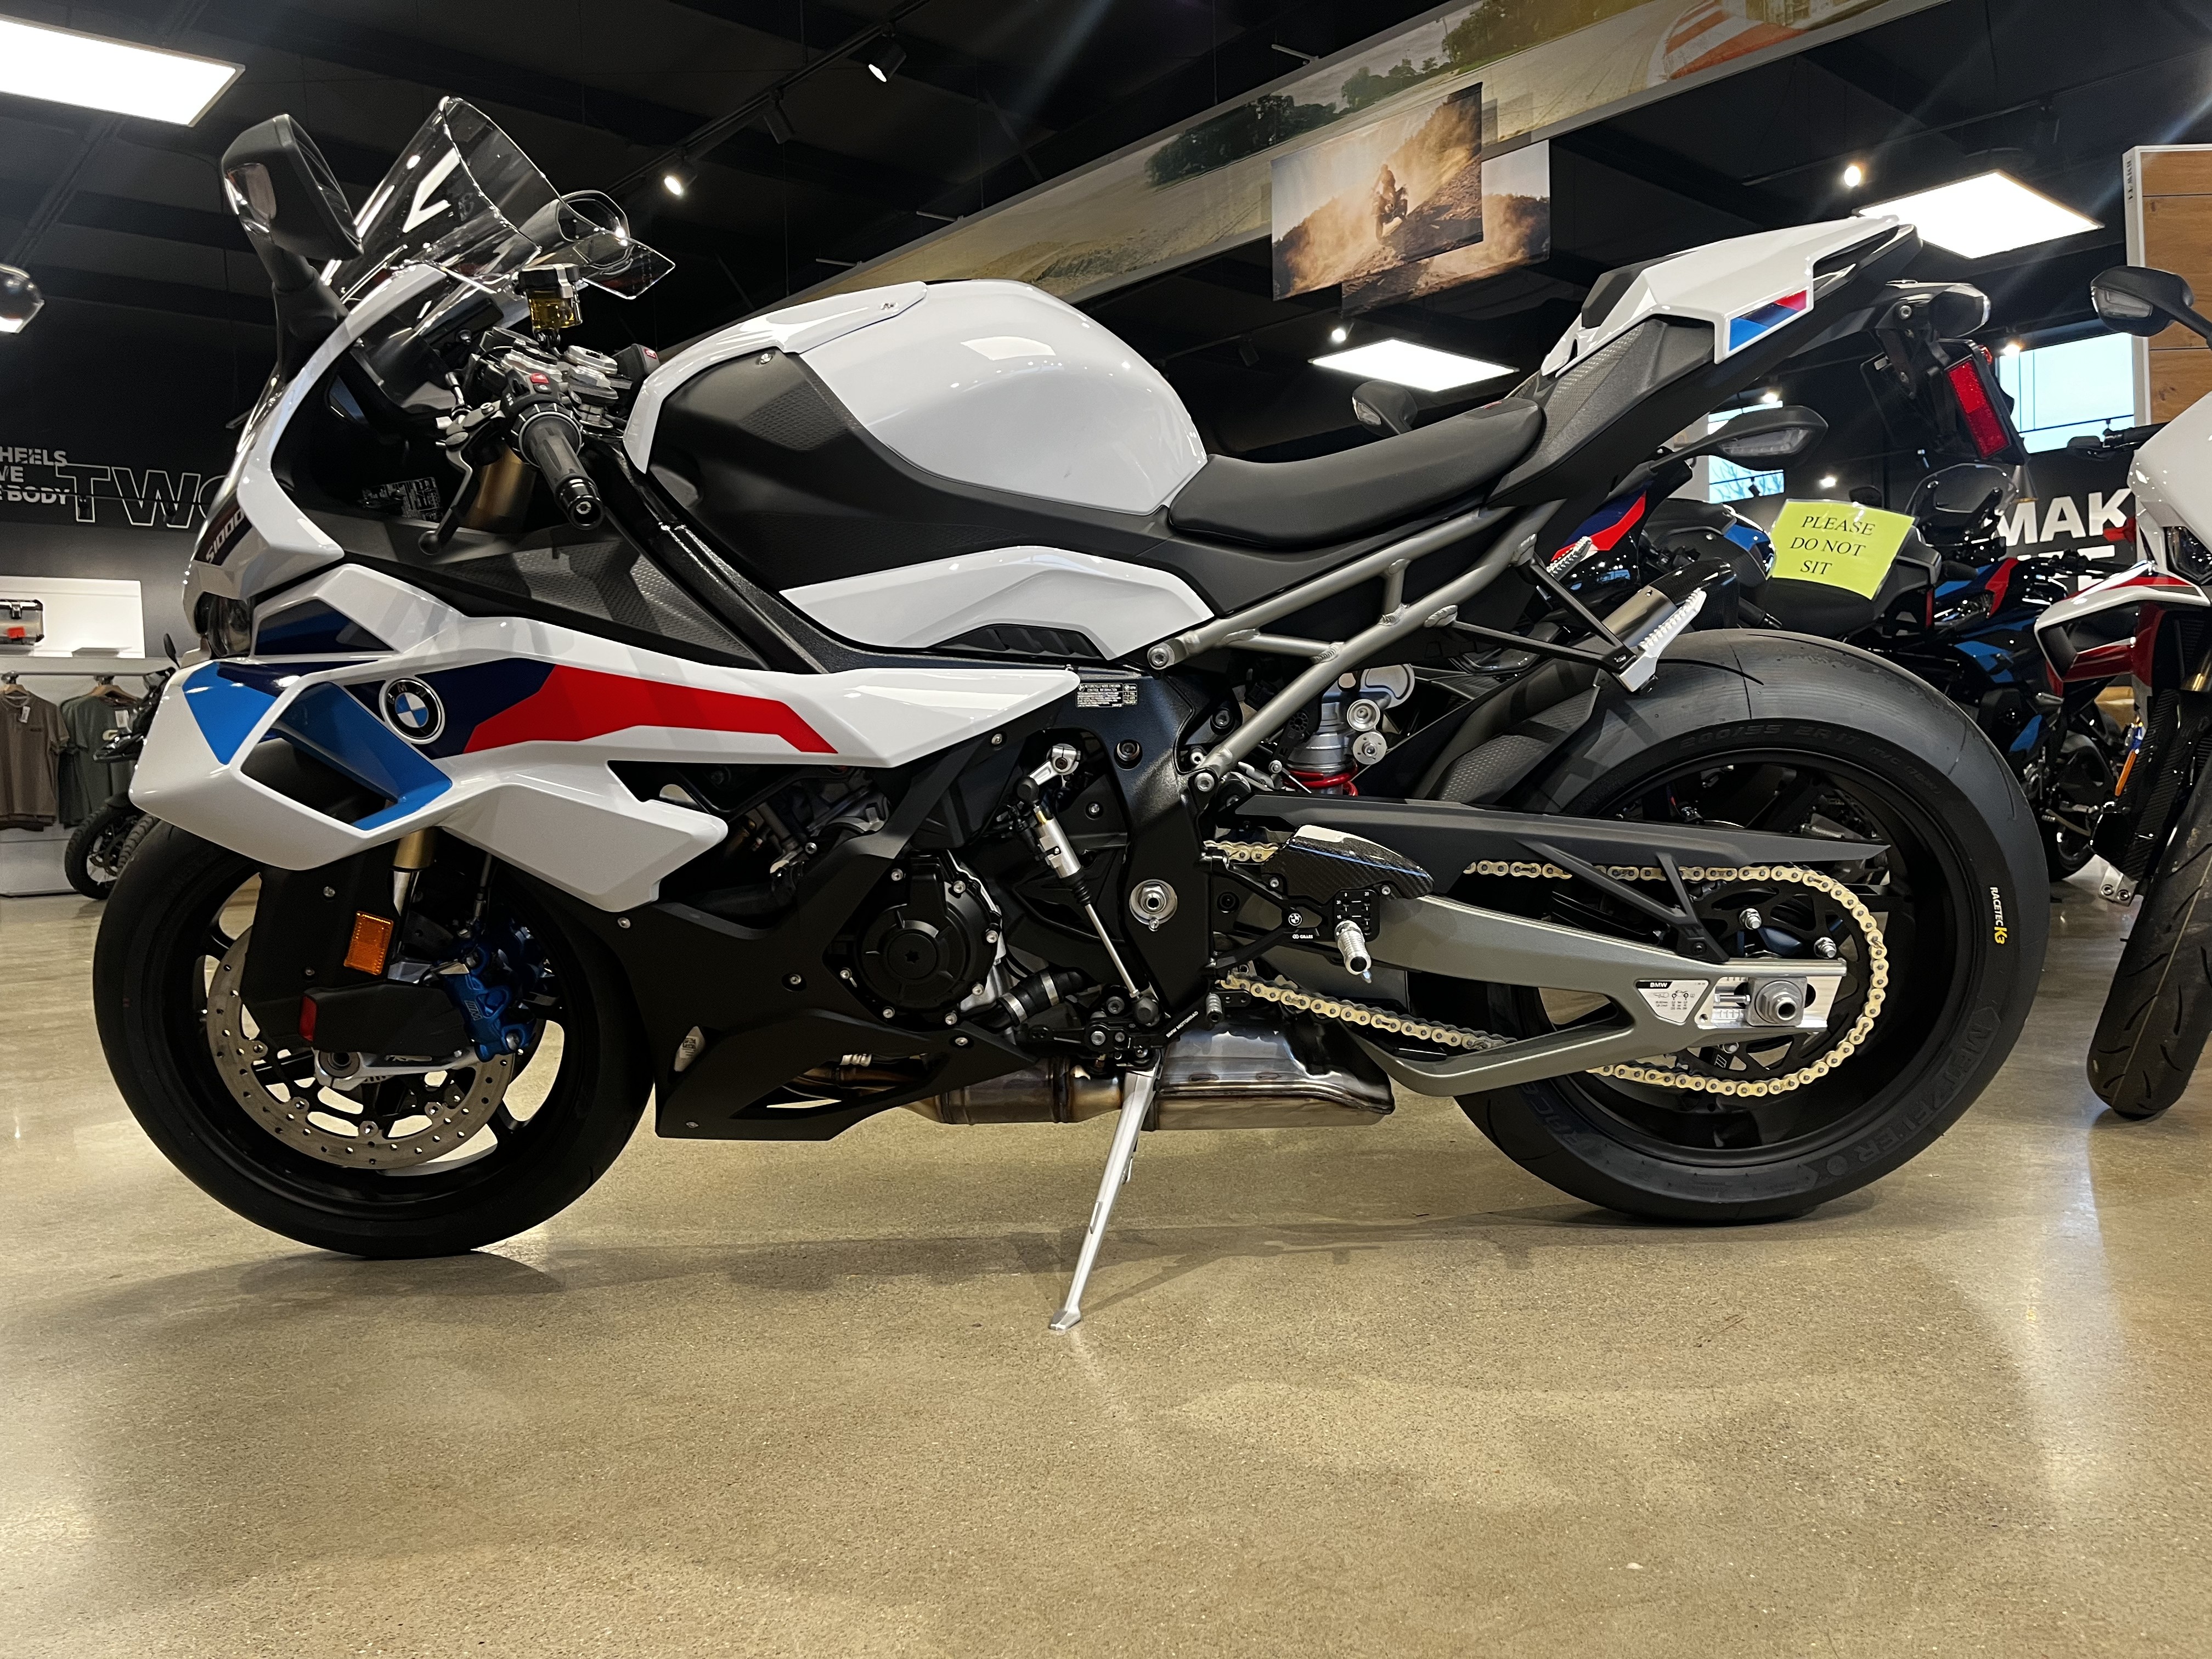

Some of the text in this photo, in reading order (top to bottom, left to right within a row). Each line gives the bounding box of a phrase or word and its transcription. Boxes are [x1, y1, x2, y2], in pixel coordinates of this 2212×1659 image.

[7, 485, 70, 505] BODY
[1801, 516, 1876, 536] PLEASE
[1790, 537, 1866, 556] DO NOT
[1800, 560, 1833, 575] SIT
[387, 681, 427, 705] BMW
[1990, 887, 2008, 944] RACETEC K3
